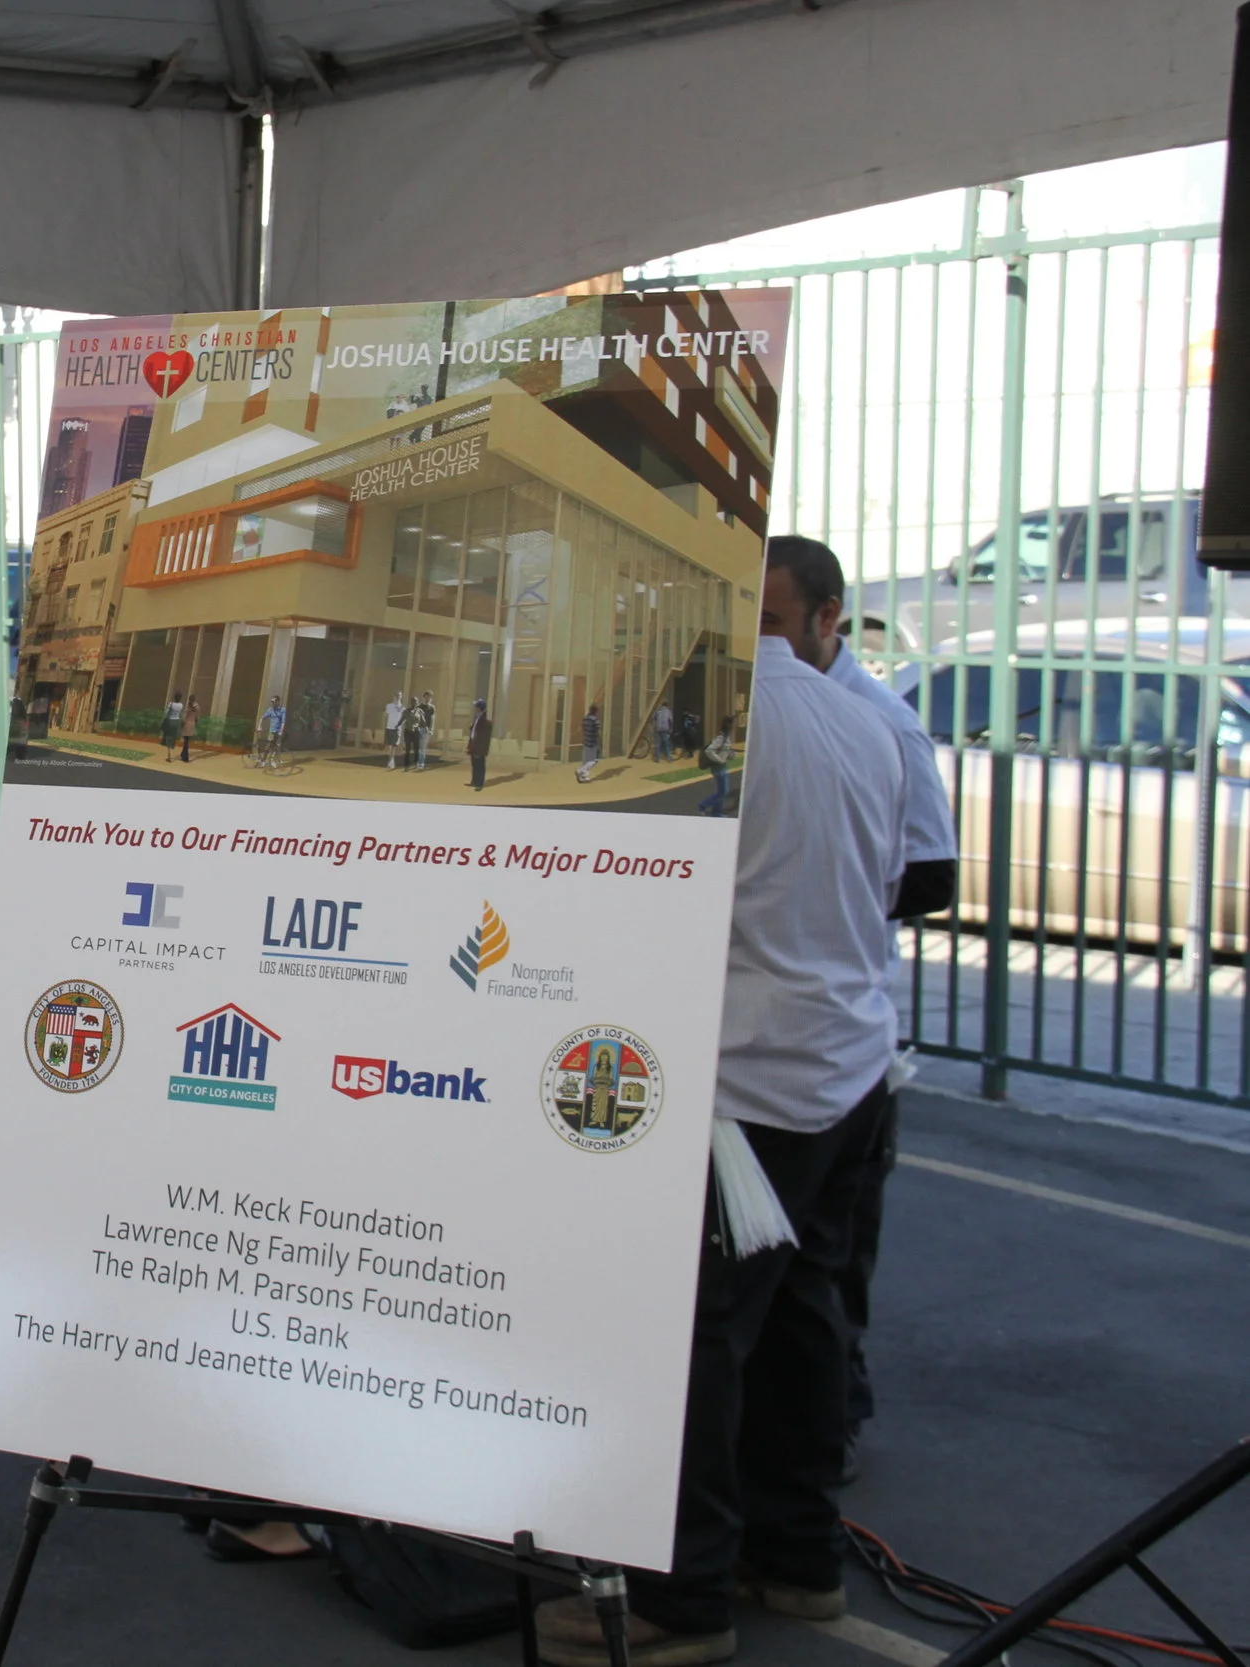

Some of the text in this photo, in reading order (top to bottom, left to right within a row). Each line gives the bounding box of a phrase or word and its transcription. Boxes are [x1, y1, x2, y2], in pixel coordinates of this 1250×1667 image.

[69, 329, 298, 353] LOS ANGELES CHRISTIAN
[327, 329, 770, 369] JOSHUA HOUSE HEALTH CENTER
[65, 347, 294, 387] HEALTH CENTERS
[350, 457, 480, 501] HEALTH CENTER
[351, 436, 482, 489] JOSHUA HOUSE
[28, 818, 695, 879] Thank You to Our Financing Partners & Major Donors
[262, 896, 362, 951] LADF
[70, 935, 226, 961] CAPITAL IMPACT
[118, 958, 175, 971] PARTNERS
[259, 960, 407, 985] LOS ANGELES DEVELOPMENT FUND
[487, 980, 537, 999] Finance
[511, 962, 575, 983] Nonprofit
[32, 983, 120, 1026] CITY OF LOS ANGELES
[182, 1012, 269, 1081] HHH
[552, 1028, 658, 1073] COUNTY OF LOS ANGELES
[38, 1067, 100, 1090] FOUNDED 1781
[170, 1083, 275, 1104] CITY OF LOS ANGELES
[567, 1132, 627, 1150] CALIFORNIA
[167, 1184, 444, 1242] W.M. Keck Foundation
[104, 1214, 506, 1291] Lawrence Ng Family Foundation
[92, 1250, 512, 1333] The Ralph M. Parsons Foundation
[231, 1308, 349, 1349] U.S. Bank
[14, 1313, 587, 1428] The Harry and Jeanette Weinberg Foundation
